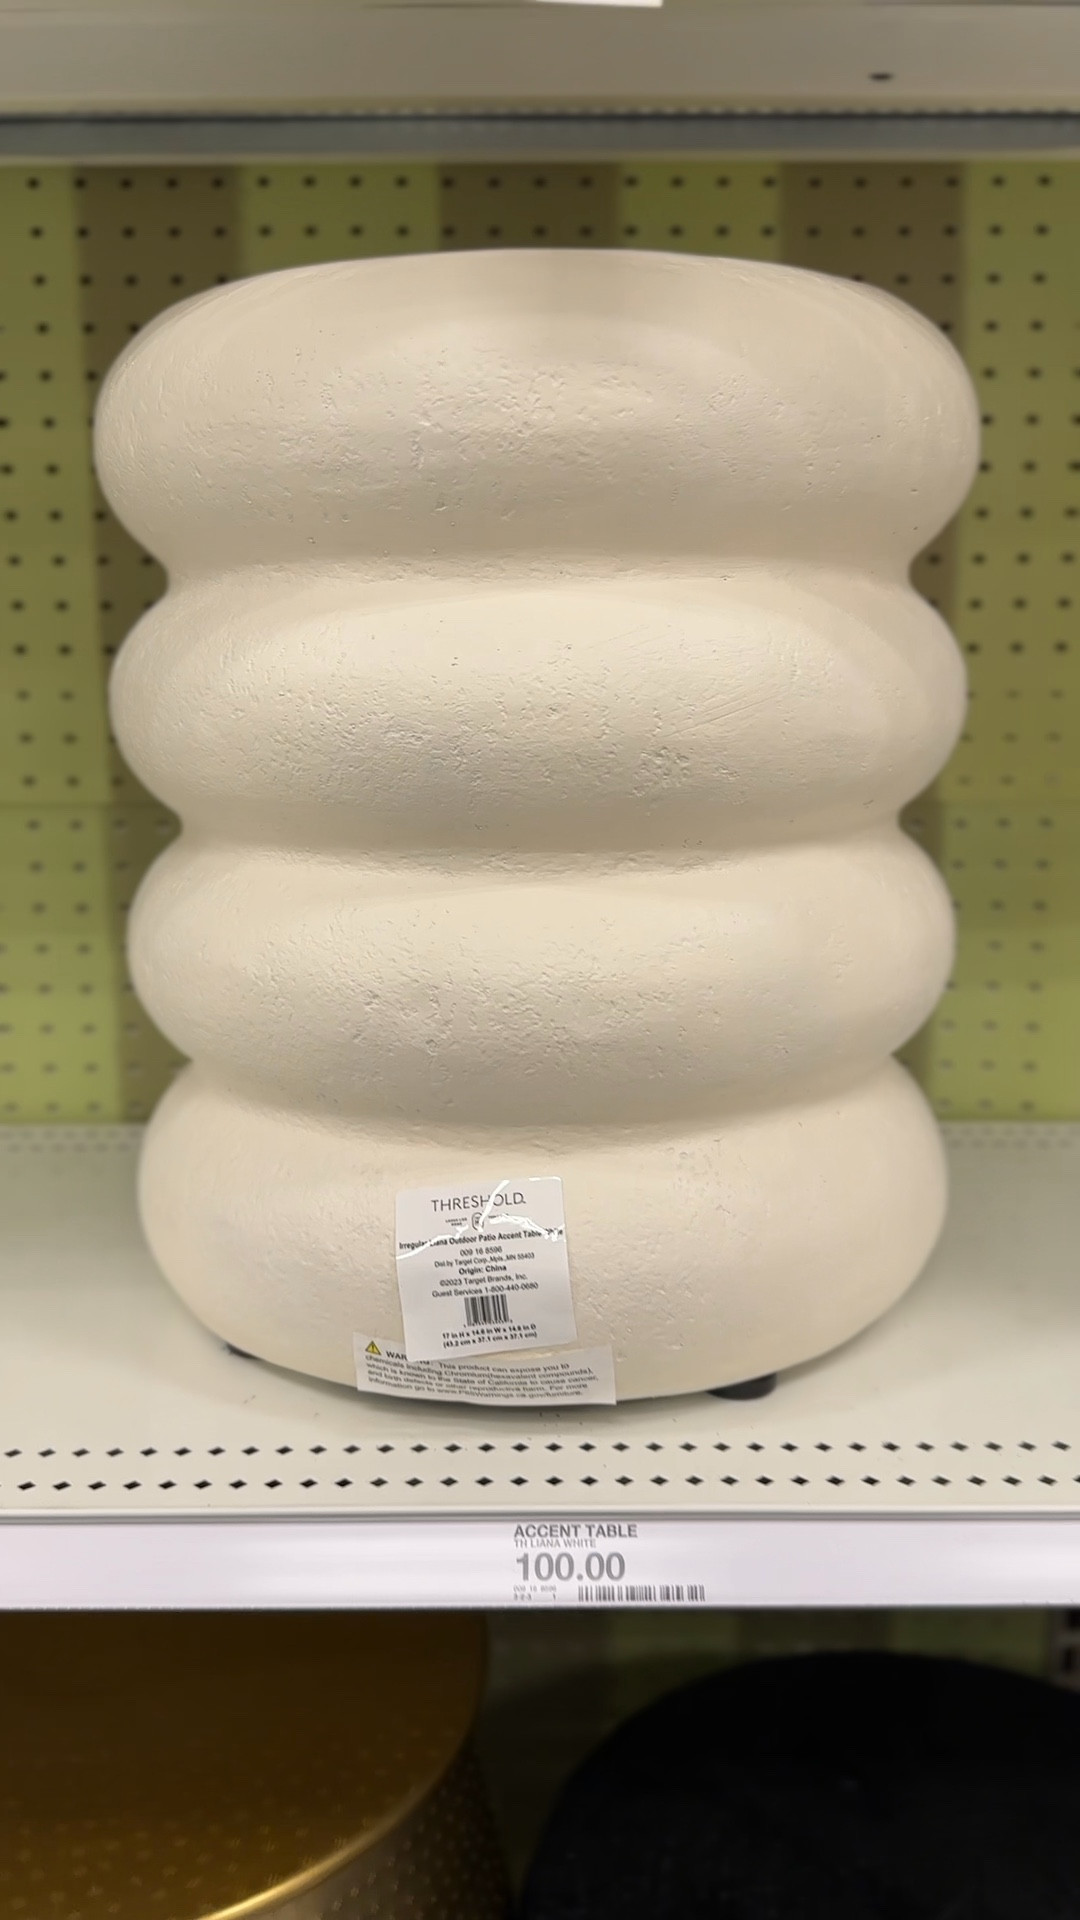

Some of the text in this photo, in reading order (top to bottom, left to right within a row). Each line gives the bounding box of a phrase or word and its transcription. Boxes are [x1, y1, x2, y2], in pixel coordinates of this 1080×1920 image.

[449, 1236, 477, 1245] Outdoor
[479, 1233, 496, 1241] Patio
[498, 1231, 522, 1240] Accent
[523, 1229, 542, 1237] Table
[460, 1248, 473, 1257] 009
[455, 1257, 472, 1266] Target
[459, 1267, 483, 1275] Origin:
[440, 1278, 462, 1286] ©2023
[464, 1276, 486, 1285] Target
[487, 1274, 514, 1283] Brands,
[453, 1287, 482, 1296] Services
[514, 1523, 638, 1538] ACCENT TABLE
[515, 1539, 596, 1548] TH LIANA WHITE
[516, 1552, 625, 1581] 100.00
